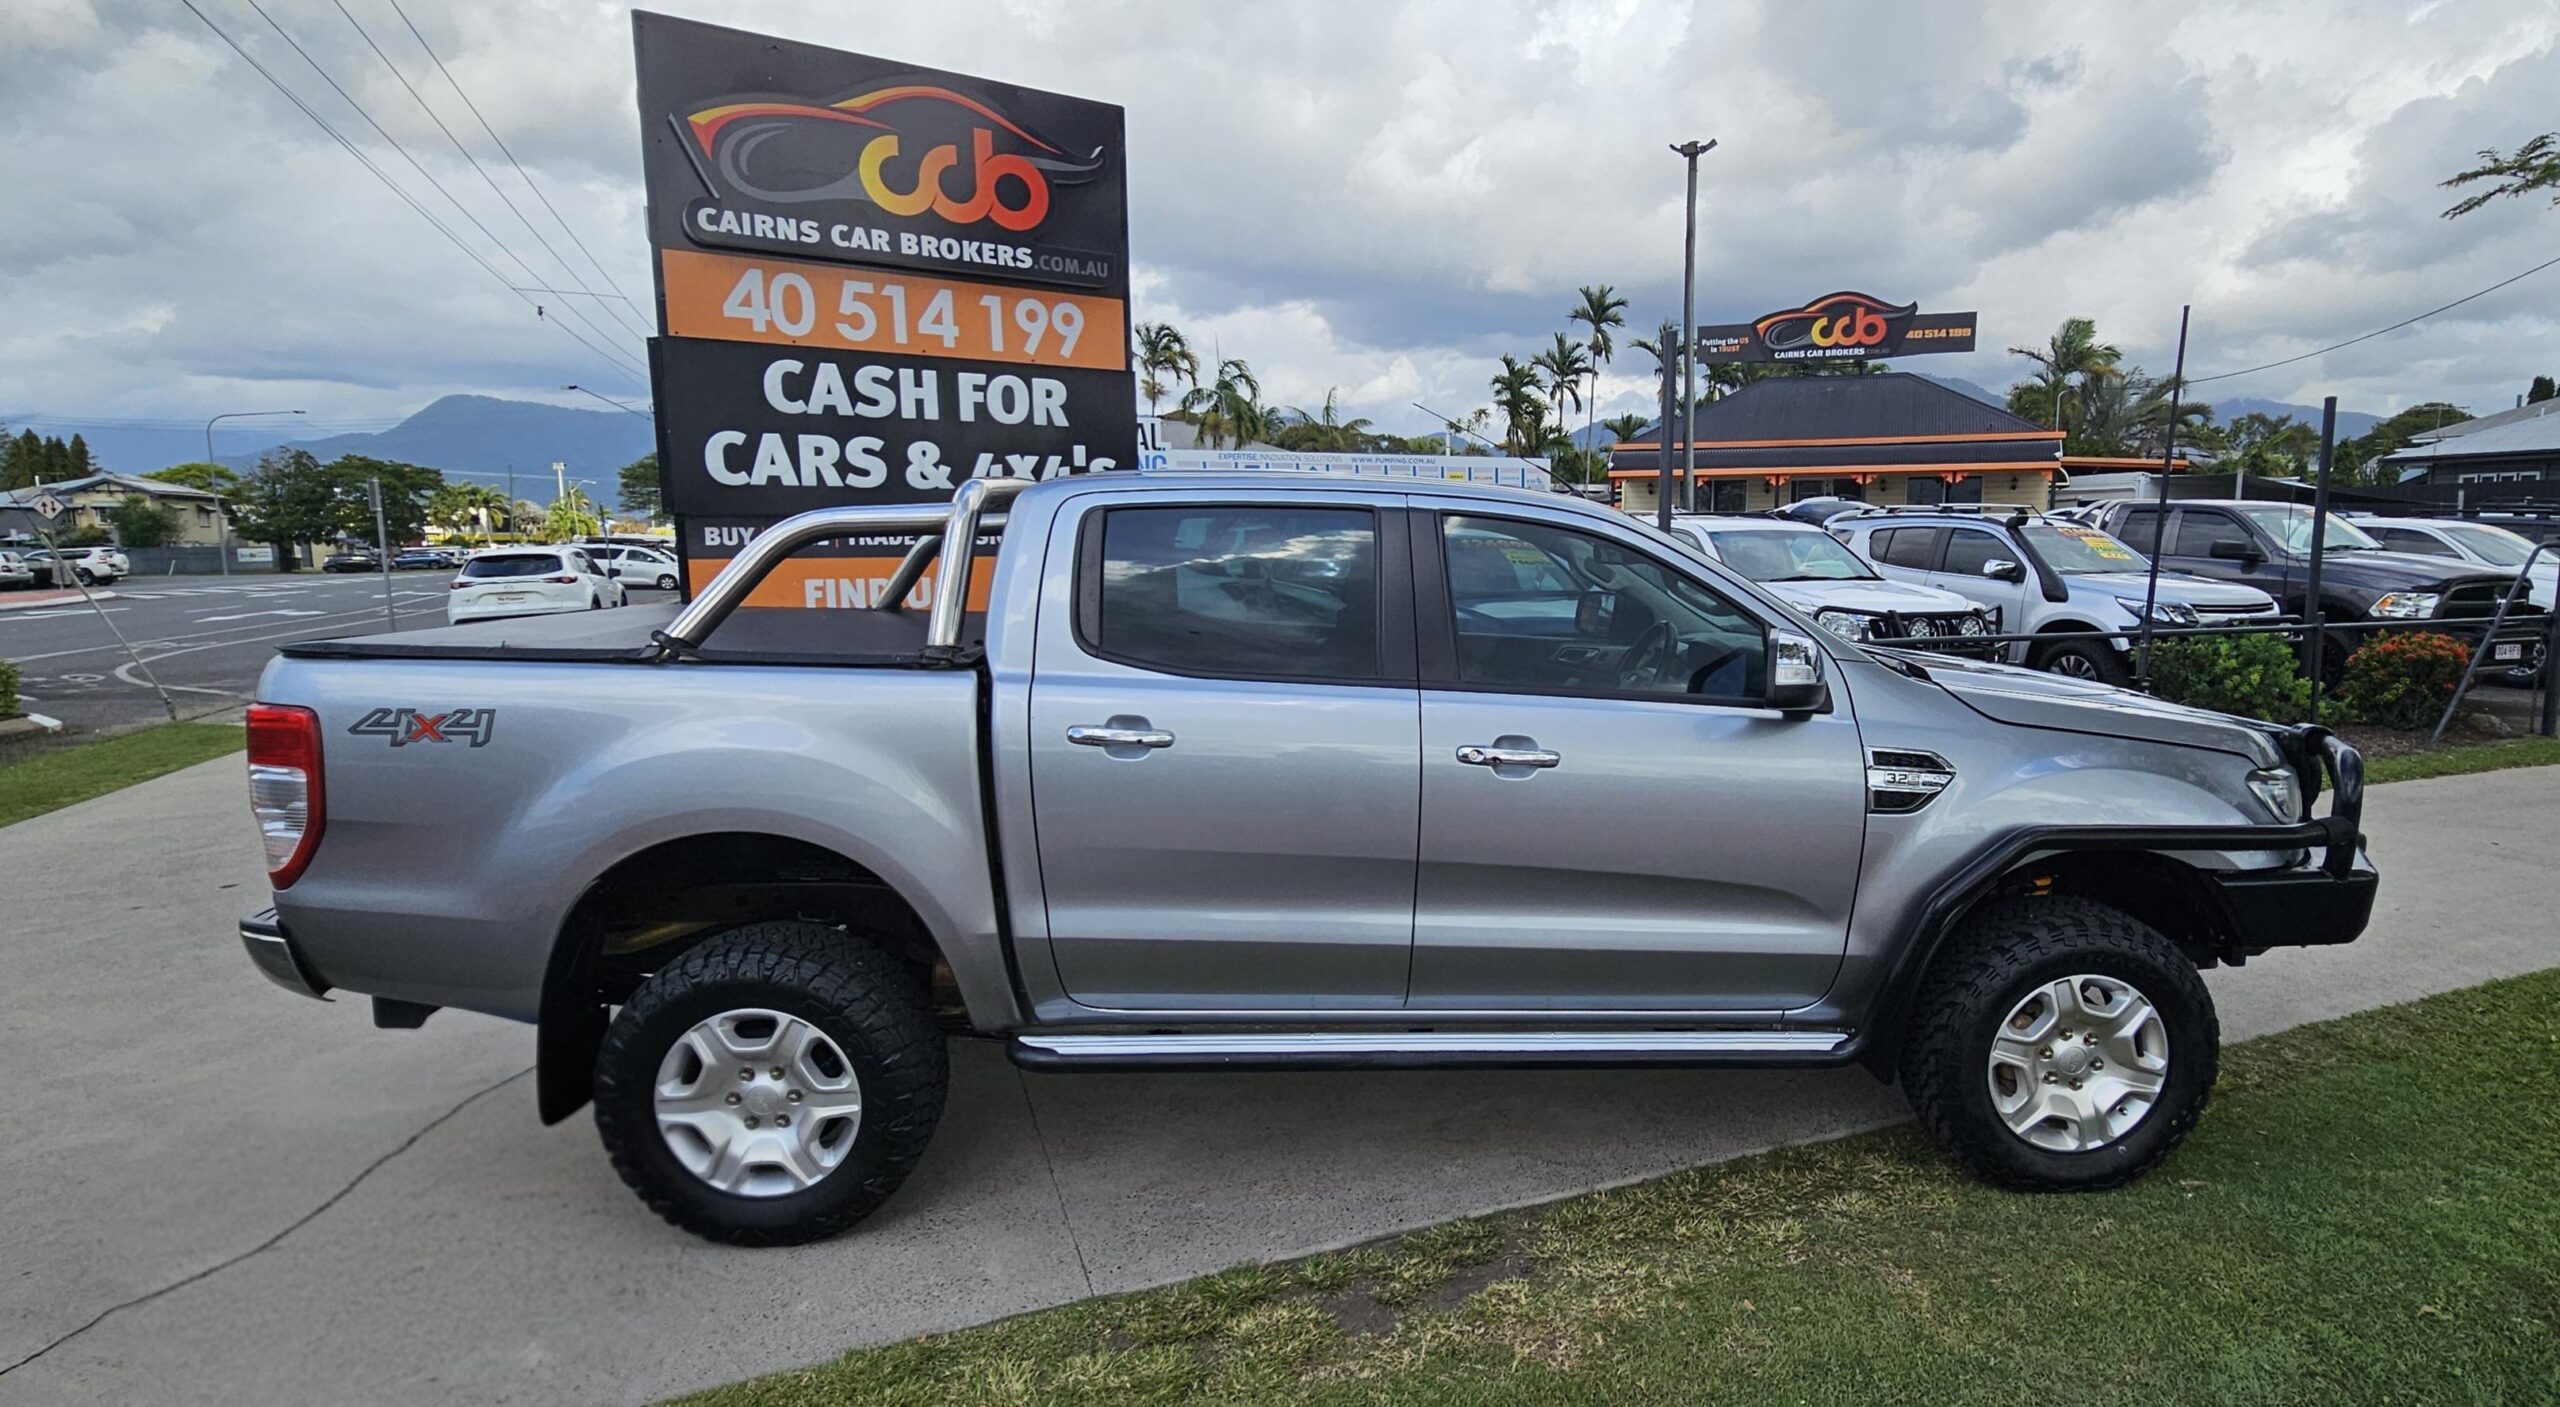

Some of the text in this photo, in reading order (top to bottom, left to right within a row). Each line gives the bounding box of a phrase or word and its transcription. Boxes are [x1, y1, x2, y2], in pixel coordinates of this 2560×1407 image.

[697, 207, 820, 243] CAIRNS
[831, 224, 890, 253] CAR
[722, 268, 1085, 359] 40 514 199
[1701, 336, 1749, 347] Putting the US
[1905, 329, 1923, 339] 40
[1924, 329, 1947, 338] 514
[1718, 345, 1740, 353] TRUST
[1774, 350, 1806, 359] CAIRNS
[1806, 349, 1824, 358] CAR
[763, 359, 1069, 427] CASH FOR
[704, 429, 888, 489] CARS
[905, 440, 953, 490] &
[1351, 456, 1436, 464] WWW.PUMPING.COM.AU
[704, 526, 755, 546] BUY
